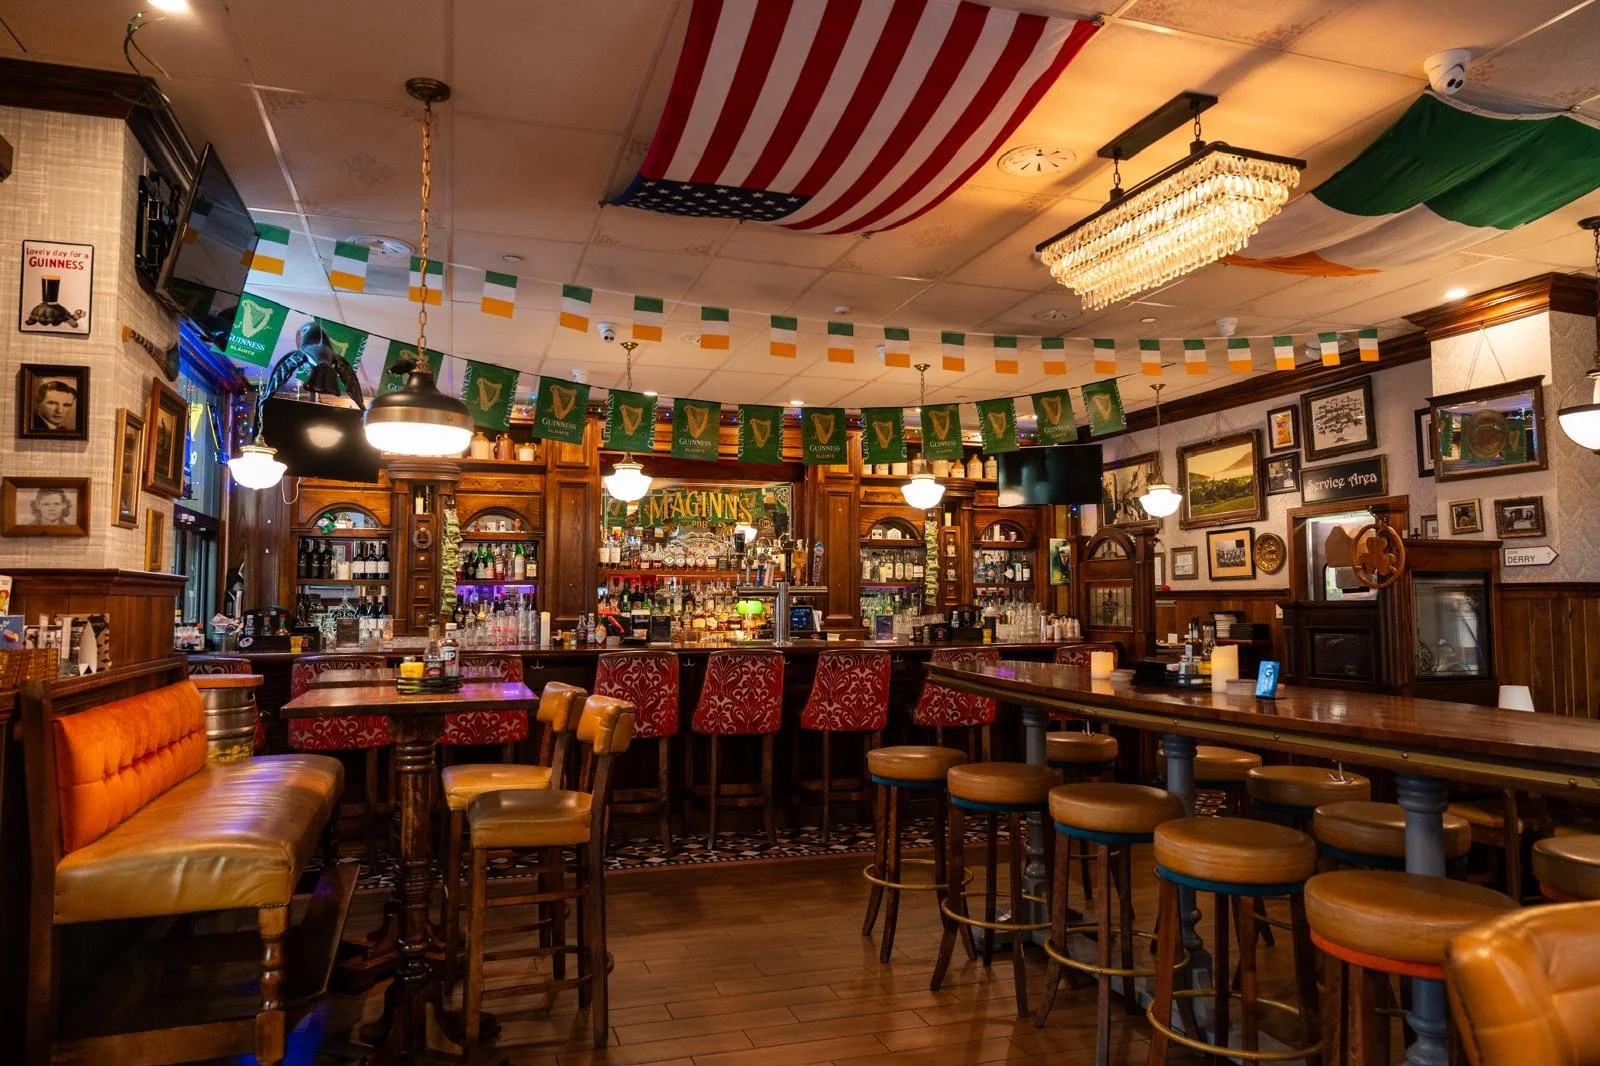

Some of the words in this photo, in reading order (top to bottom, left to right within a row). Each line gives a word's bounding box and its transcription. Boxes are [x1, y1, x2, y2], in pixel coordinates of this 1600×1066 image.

[27, 247, 50, 256] Lovely
[53, 250, 67, 258] day
[29, 256, 84, 271] GUINNESS
[542, 417, 576, 430] GUINNESS
[603, 393, 615, 443] GUINNESS
[647, 400, 658, 449] GUINNESS
[679, 437, 712, 447] GUINNESS
[861, 412, 870, 461] GUINNESS
[809, 444, 840, 453] GUINNESS
[1307, 476, 1345, 491] Service
[1348, 472, 1378, 487] Area
[1507, 555, 1535, 564] DERRY
